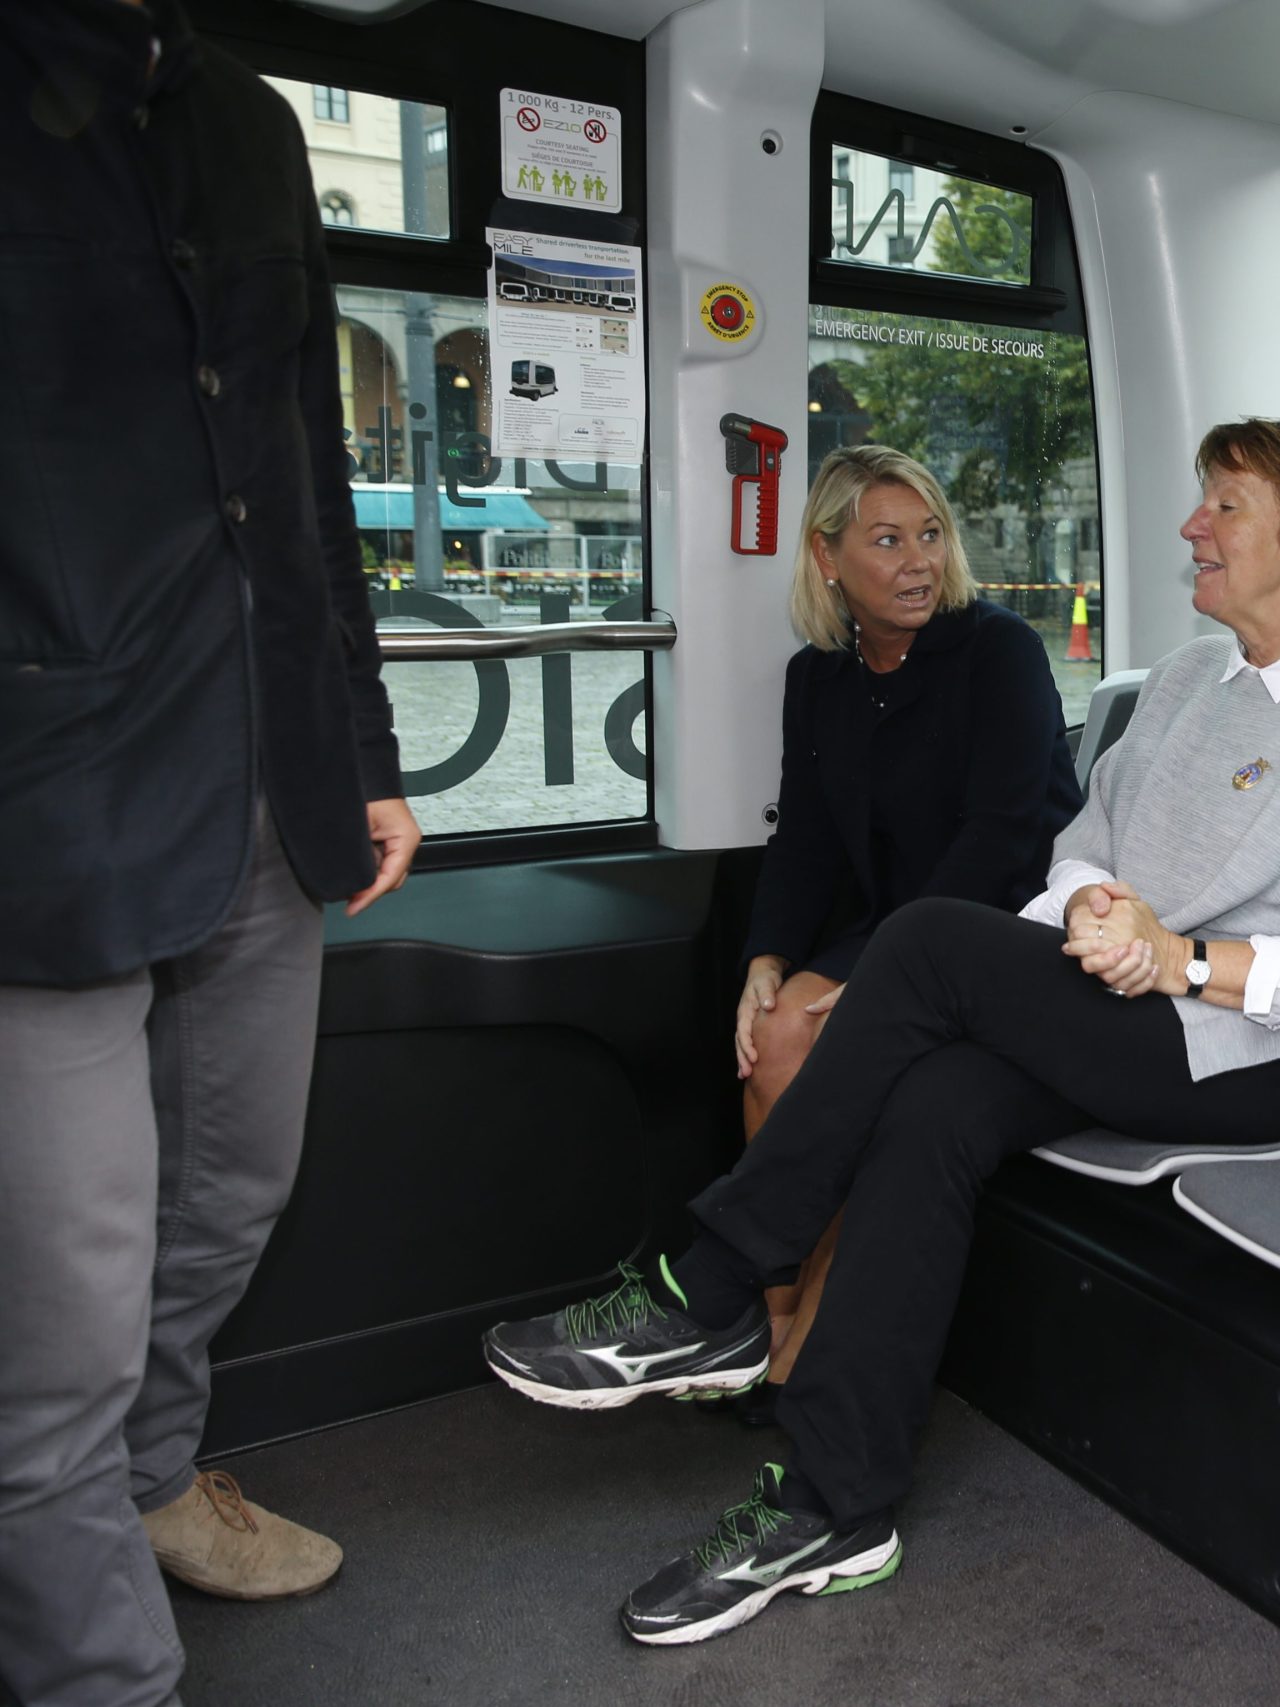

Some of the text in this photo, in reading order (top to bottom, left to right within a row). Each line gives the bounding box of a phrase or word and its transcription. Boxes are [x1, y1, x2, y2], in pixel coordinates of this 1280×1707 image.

[507, 92, 514, 102] 1
[518, 94, 541, 107] 000
[545, 98, 559, 112] Kg
[570, 103, 584, 114] 12
[588, 106, 615, 121] Pers.
[535, 138, 565, 149] COURTESY
[565, 143, 590, 153] SEATING
[493, 232, 534, 246] EASY
[535, 237, 557, 246] Shared
[558, 239, 588, 250] driverless
[493, 242, 534, 256] MILE
[605, 254, 617, 262] last
[617, 255, 631, 264] mile
[737, 290, 748, 301] STOP
[815, 319, 895, 343] EMERGENCY
[898, 328, 926, 346] EXIT
[927, 332, 934, 348] /
[936, 331, 969, 351] ISSUE
[972, 336, 989, 353] DE
[991, 338, 1045, 358] SECOURS
